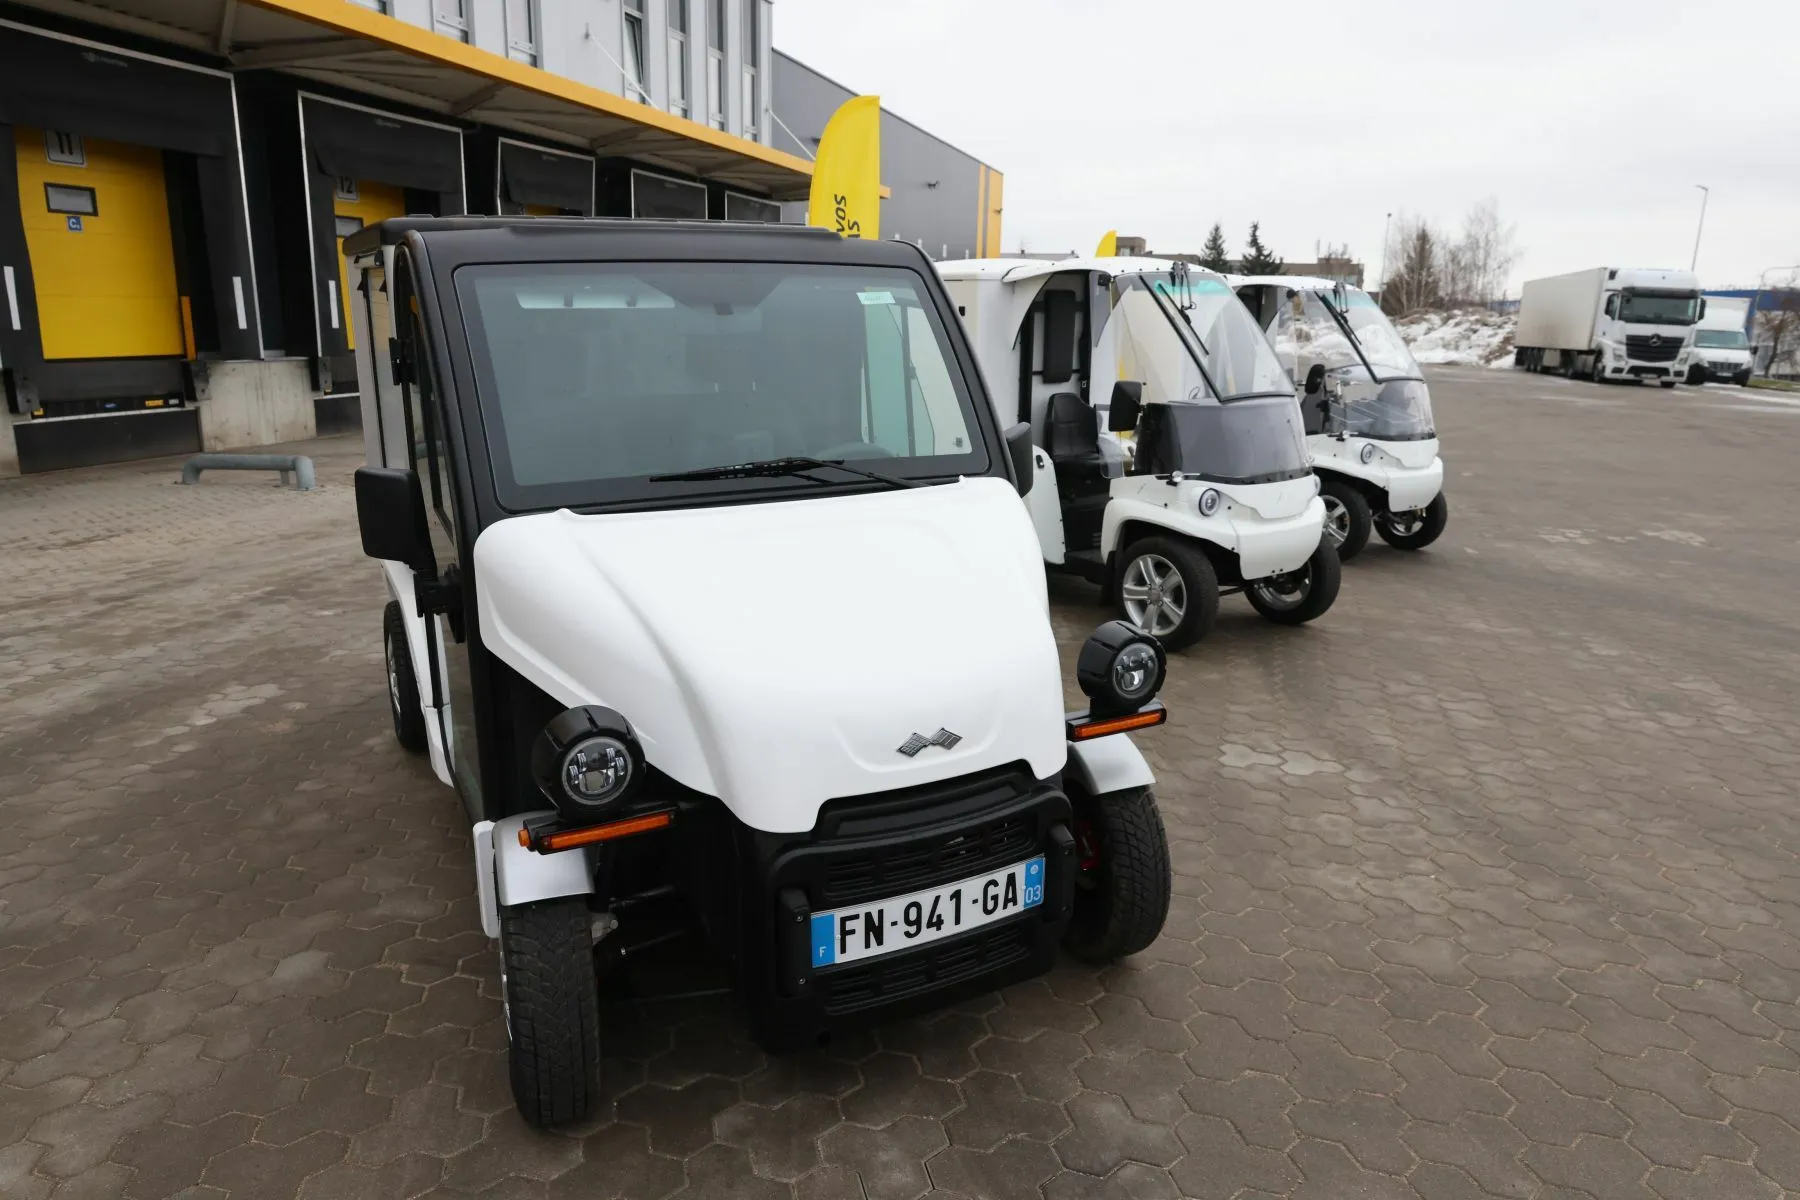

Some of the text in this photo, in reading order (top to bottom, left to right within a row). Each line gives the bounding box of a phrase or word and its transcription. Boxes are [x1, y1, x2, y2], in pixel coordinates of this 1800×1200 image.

[56, 131, 74, 156] 11
[340, 175, 354, 195] 12
[1025, 885, 1042, 903] 03
[840, 872, 1018, 955] FN-941-GA
[819, 946, 827, 958] F
